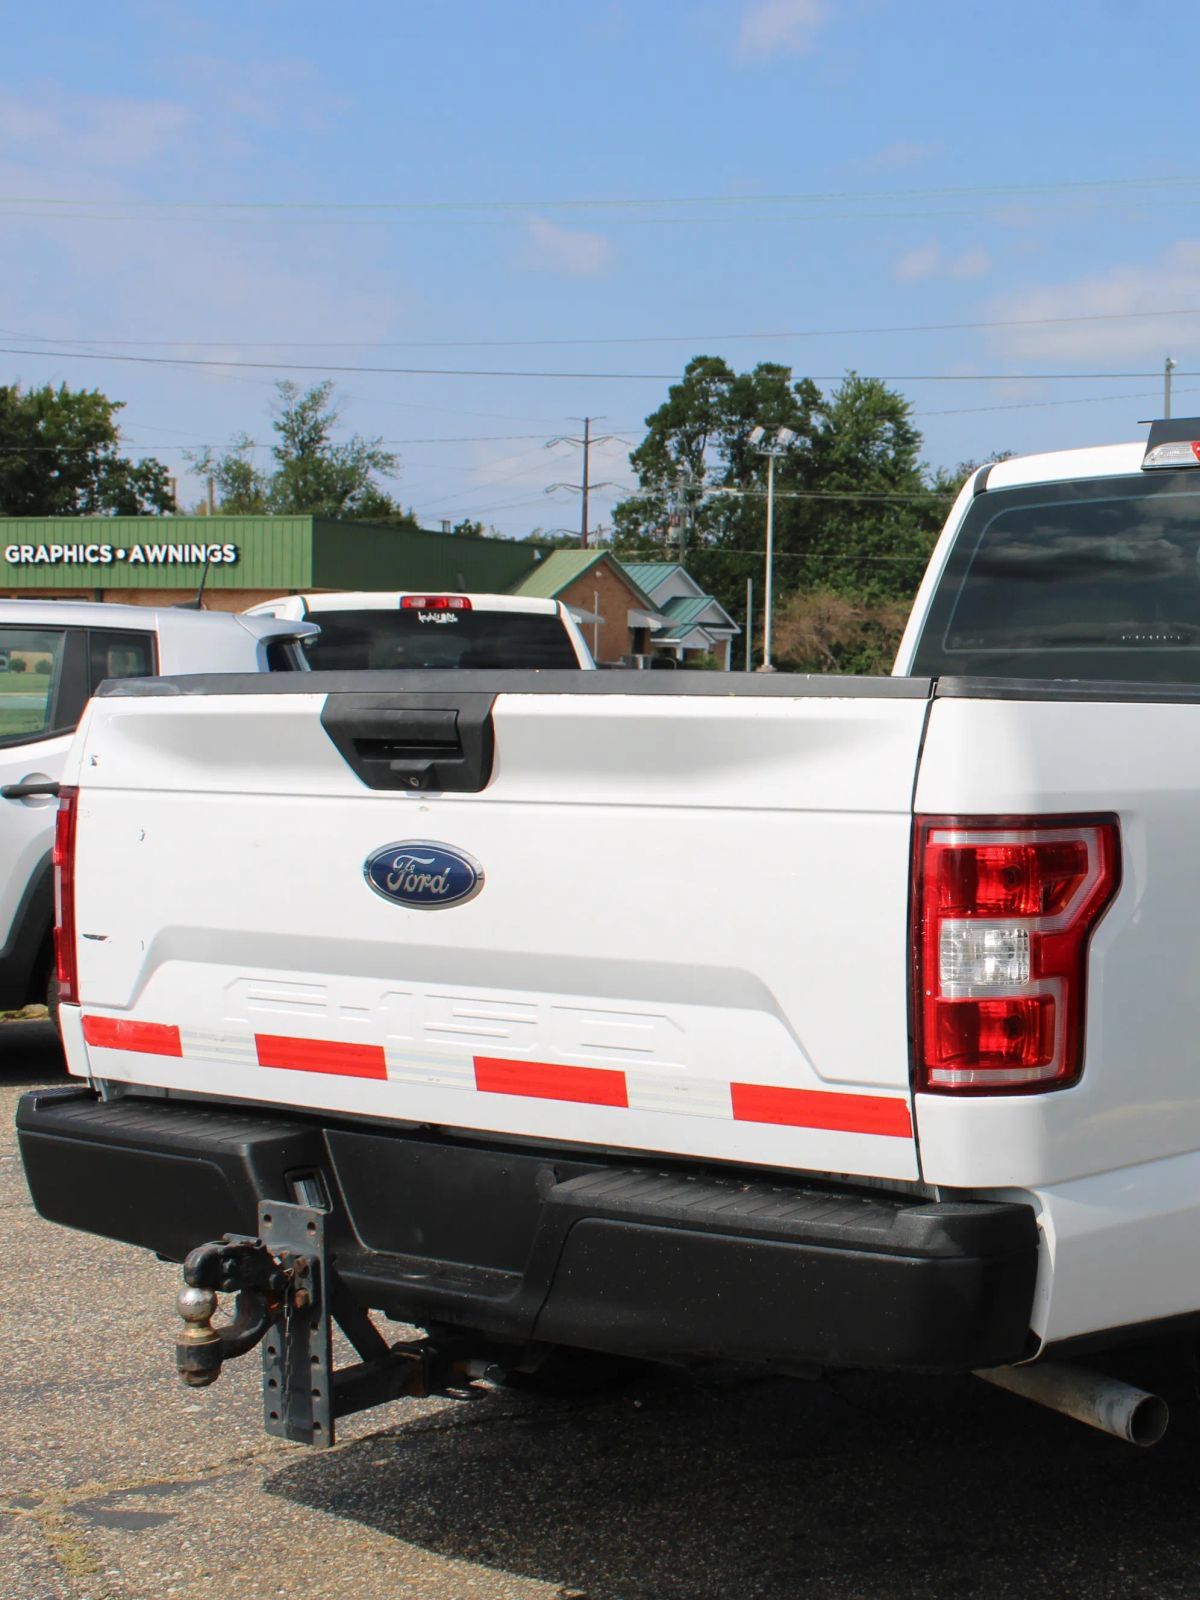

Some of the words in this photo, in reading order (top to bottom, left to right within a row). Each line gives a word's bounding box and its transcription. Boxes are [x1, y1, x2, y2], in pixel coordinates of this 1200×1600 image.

[5, 544, 112, 563] GRAPHICS
[129, 544, 236, 563] AWNINGS
[387, 855, 450, 894] Ford
